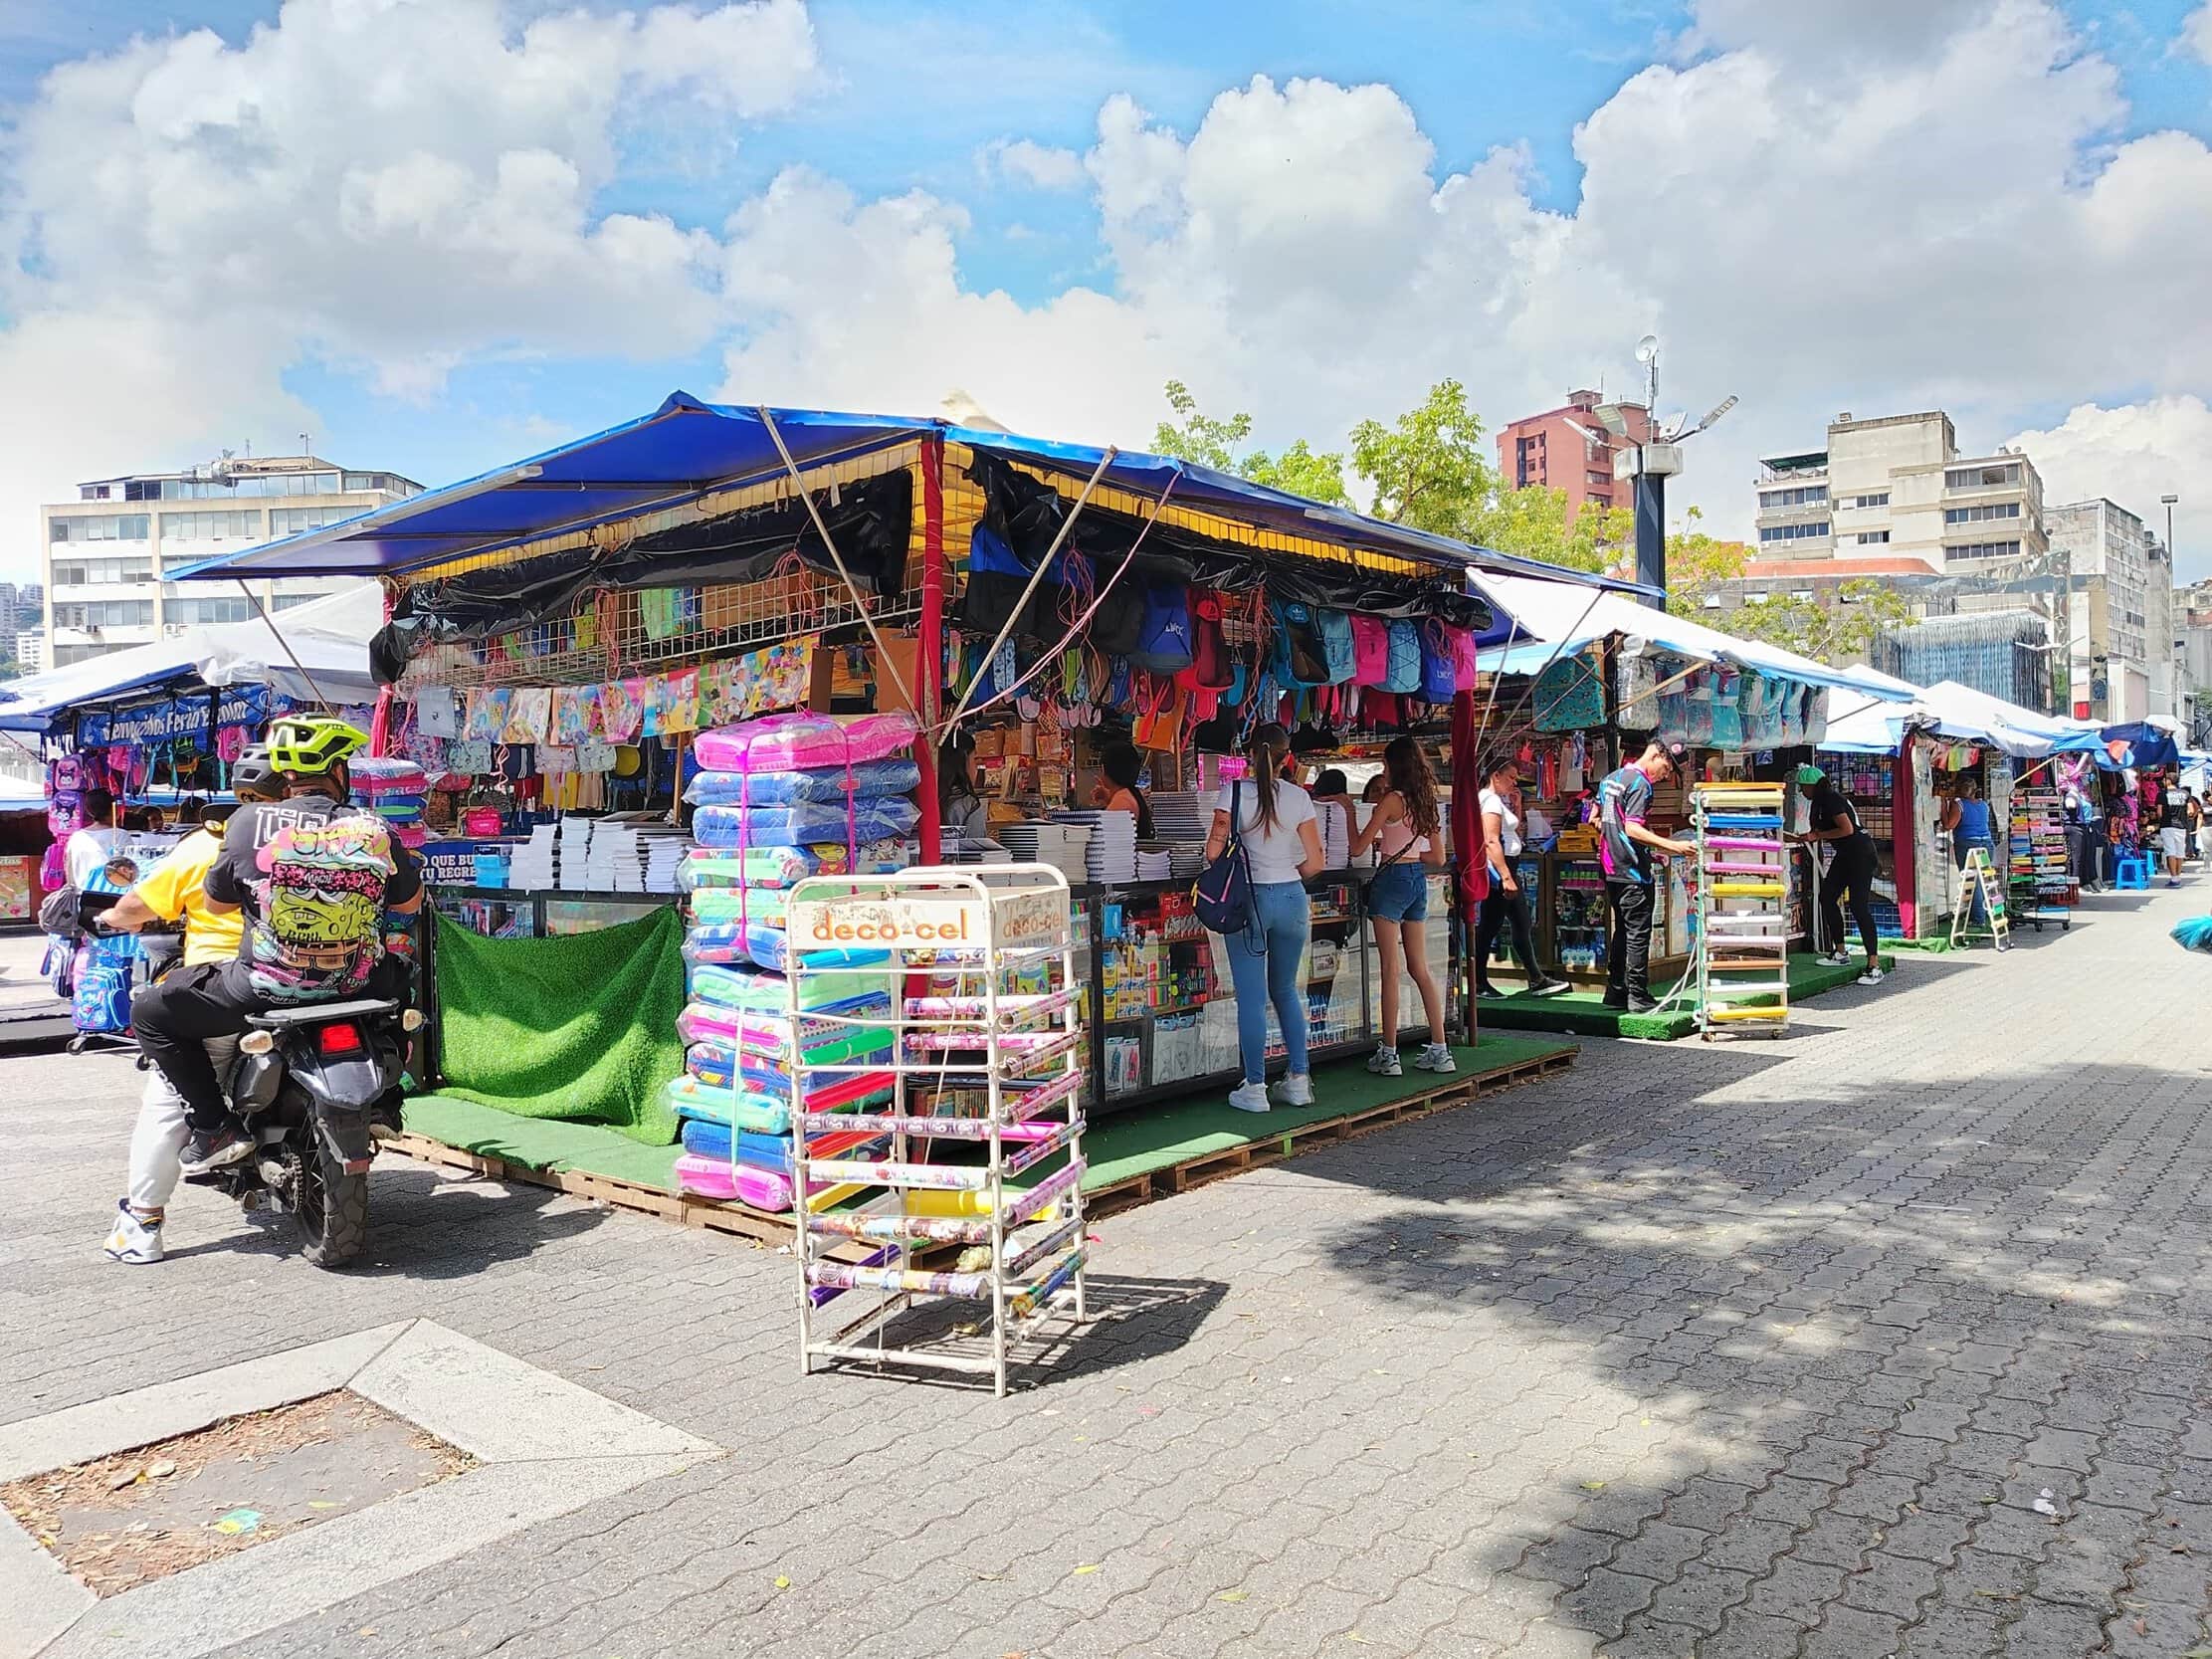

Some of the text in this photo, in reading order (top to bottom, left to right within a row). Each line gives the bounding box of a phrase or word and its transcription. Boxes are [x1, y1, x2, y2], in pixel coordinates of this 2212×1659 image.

[201, 701, 249, 727] Ecolar
[431, 855, 456, 869] QUE
[438, 867, 478, 878] REGRE
[812, 908, 967, 940] deco-cel
